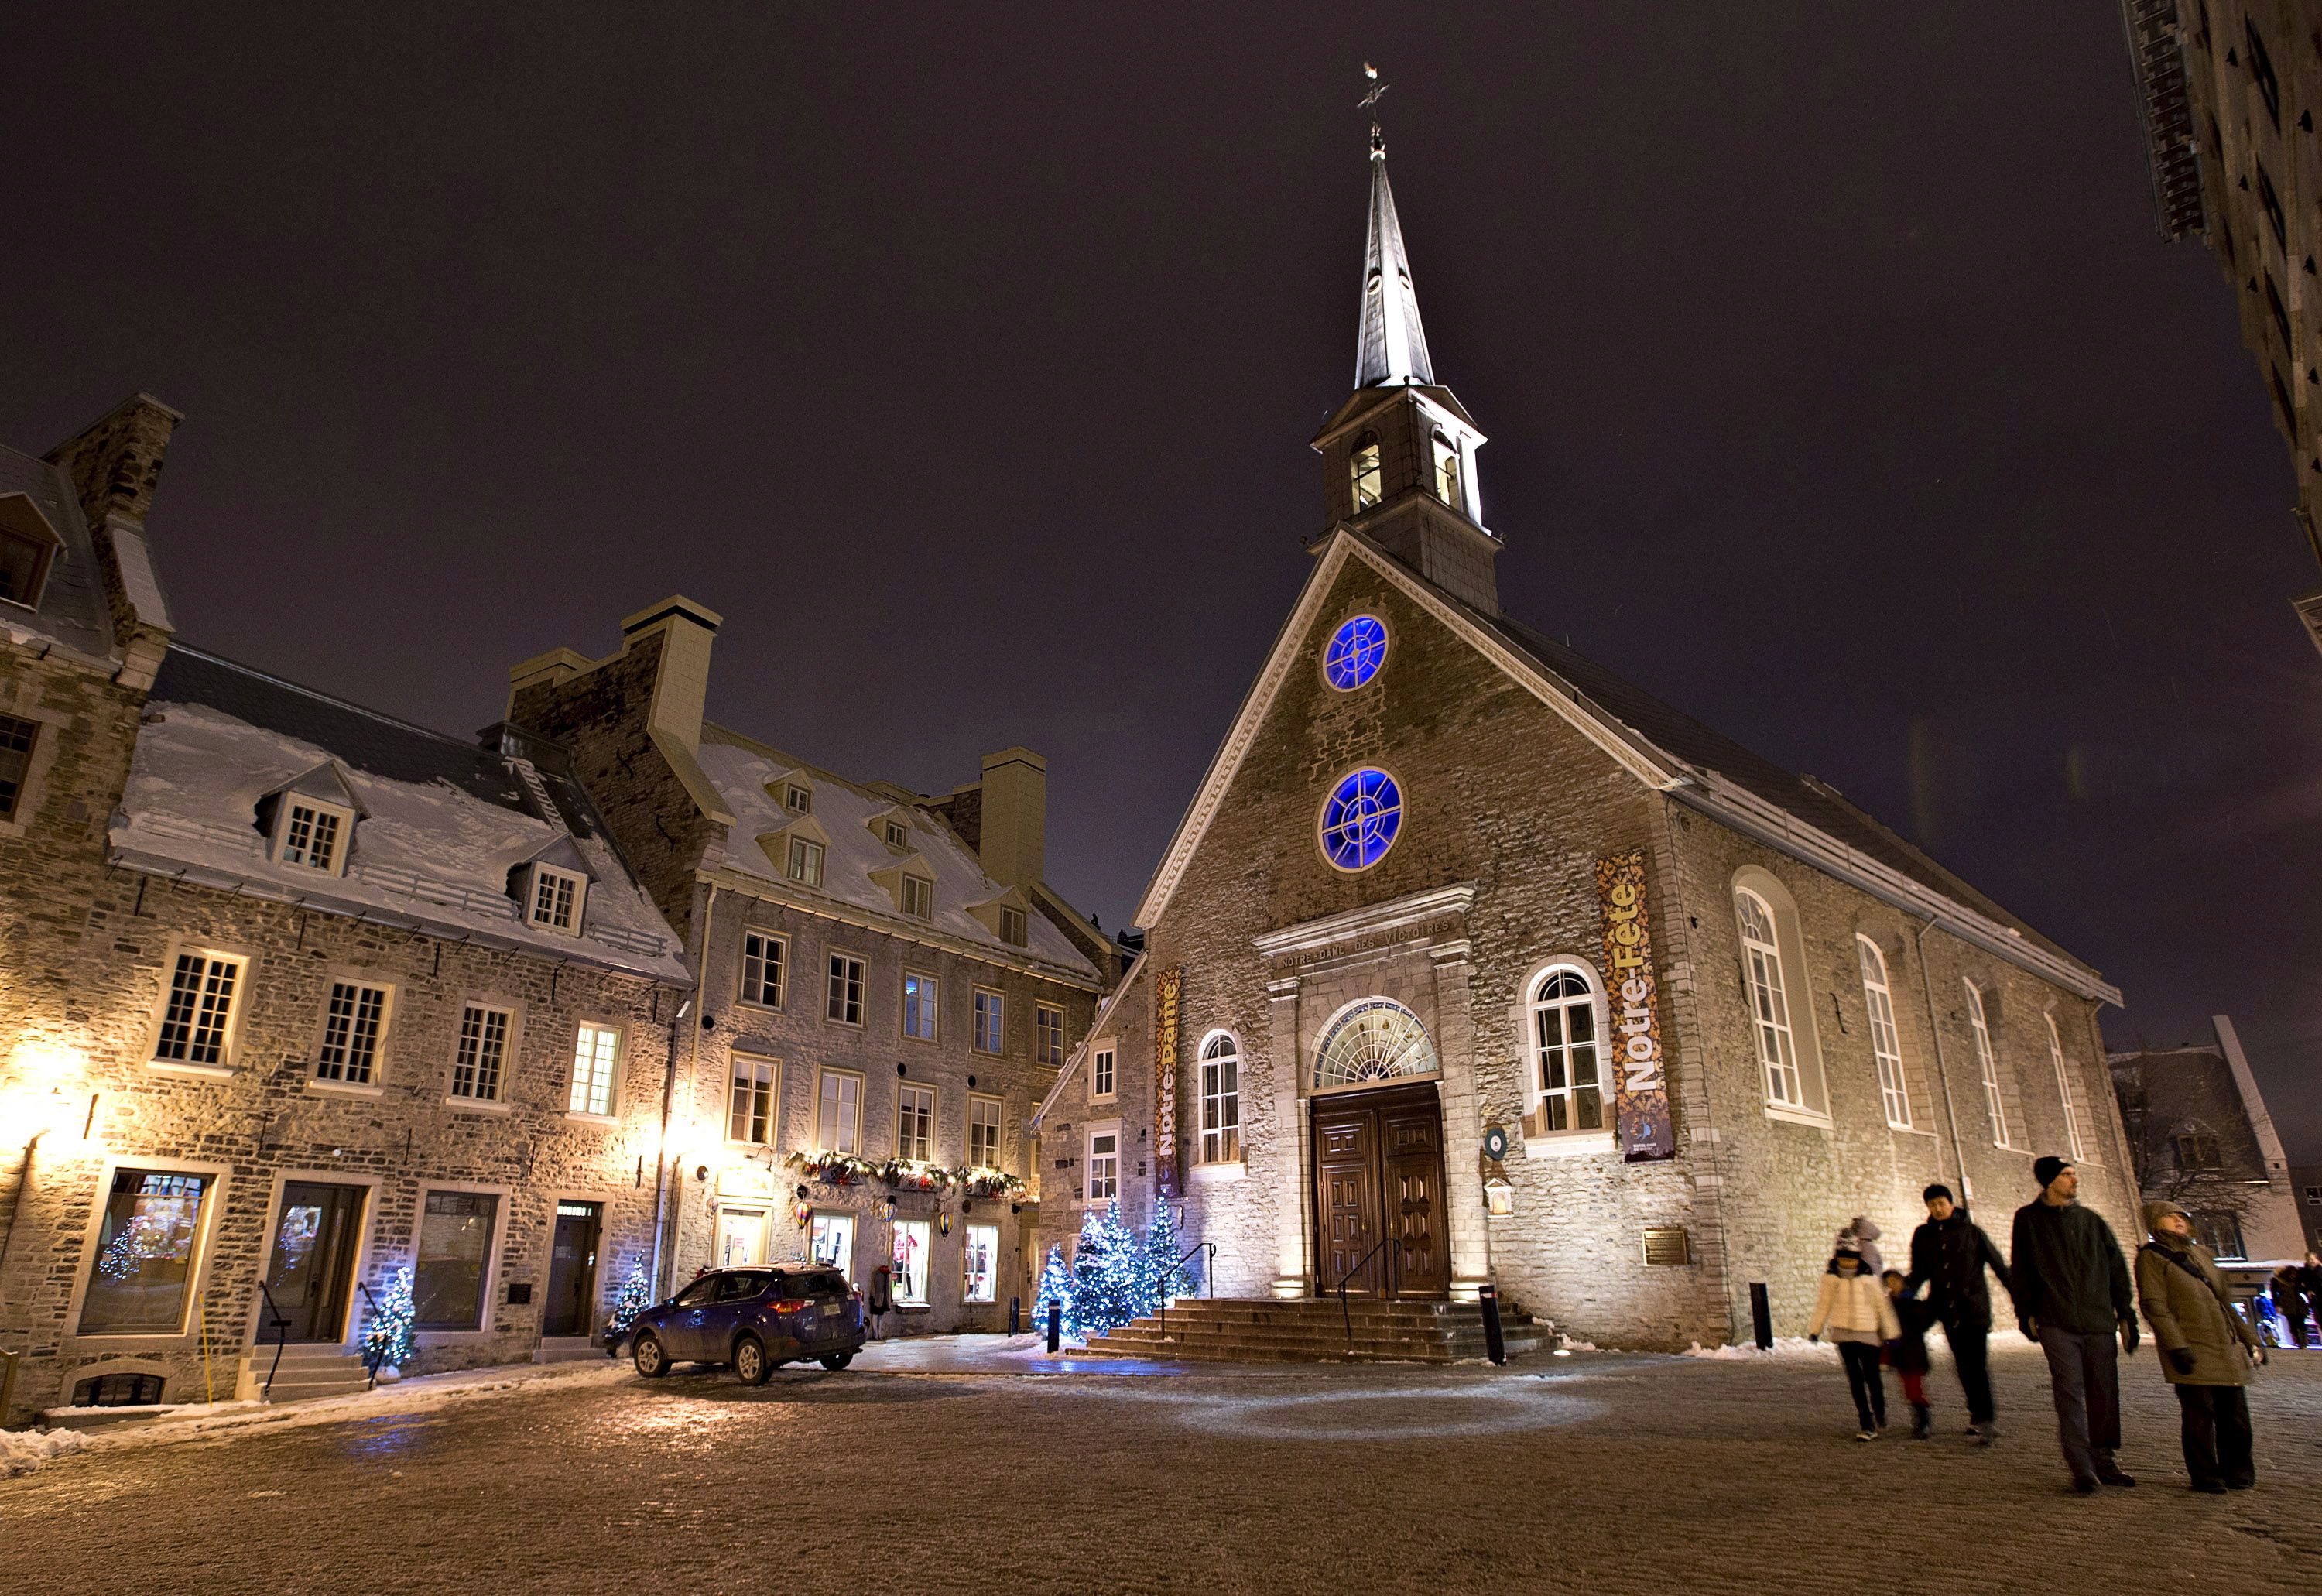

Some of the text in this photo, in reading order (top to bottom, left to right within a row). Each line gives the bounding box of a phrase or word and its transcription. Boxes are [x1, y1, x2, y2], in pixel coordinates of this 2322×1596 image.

[1354, 939, 1375, 951] DES
[1385, 920, 1449, 944] VICTOIRES
[1609, 884, 1656, 1091] Notre-Fête
[1159, 982, 1177, 1156] Notre-Dame
